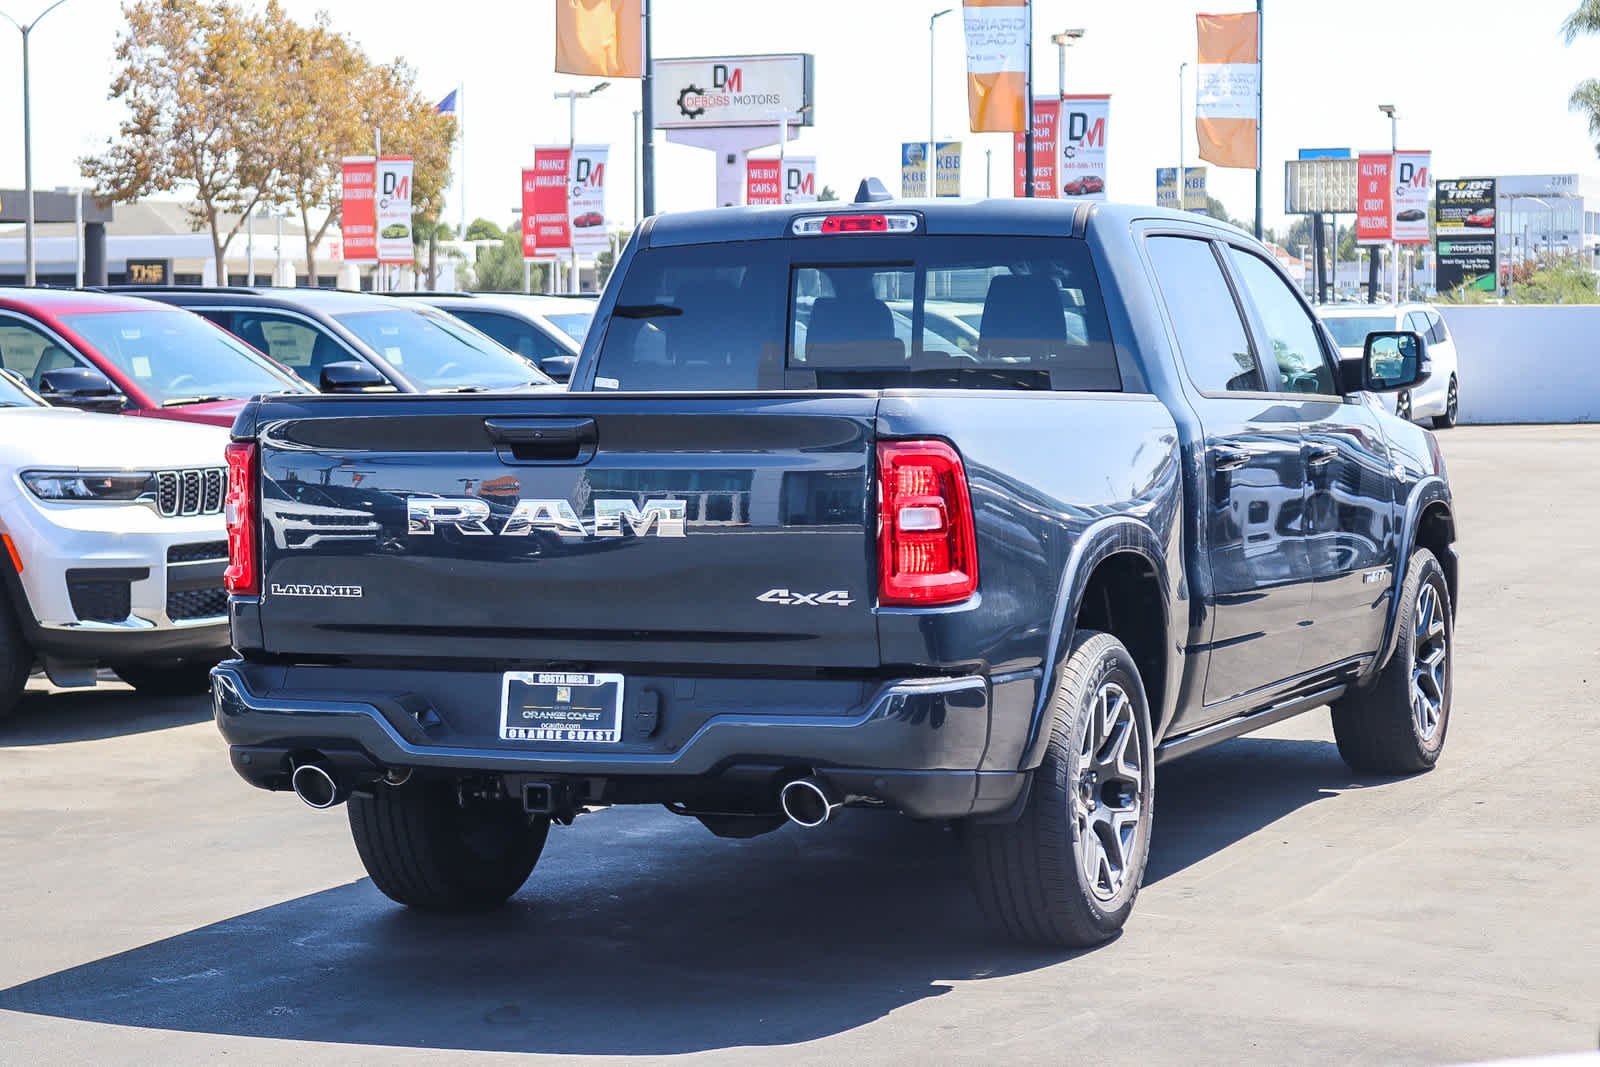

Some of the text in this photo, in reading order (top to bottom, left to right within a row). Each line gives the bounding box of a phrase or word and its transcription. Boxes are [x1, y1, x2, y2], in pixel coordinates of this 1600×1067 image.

[733, 94, 781, 106] MOTORS
[1069, 112, 1105, 147] DM
[538, 159, 566, 170] FINANCE
[936, 155, 960, 169] KBB
[576, 158, 605, 188] DM
[750, 168, 779, 179] WE BUY
[1362, 164, 1387, 175] ALL TYPE
[1400, 162, 1427, 188] DM
[536, 175, 567, 186] AVAILABLE
[787, 168, 815, 195] DM
[903, 172, 926, 181] KBB
[383, 171, 409, 200] DM
[751, 183, 778, 193] CARS &
[1369, 182, 1378, 193] OF
[1447, 190, 1484, 199] TIRE
[1363, 199, 1384, 211] CREDIT
[1359, 216, 1388, 228] WELCOME
[130, 264, 163, 280] THE
[407, 498, 688, 537] RAM
[271, 583, 362, 598] LARAMIE
[538, 674, 589, 684] COSTA MESA
[522, 711, 601, 720] ORANGE COAST
[508, 729, 612, 740] ORANGE COAST
